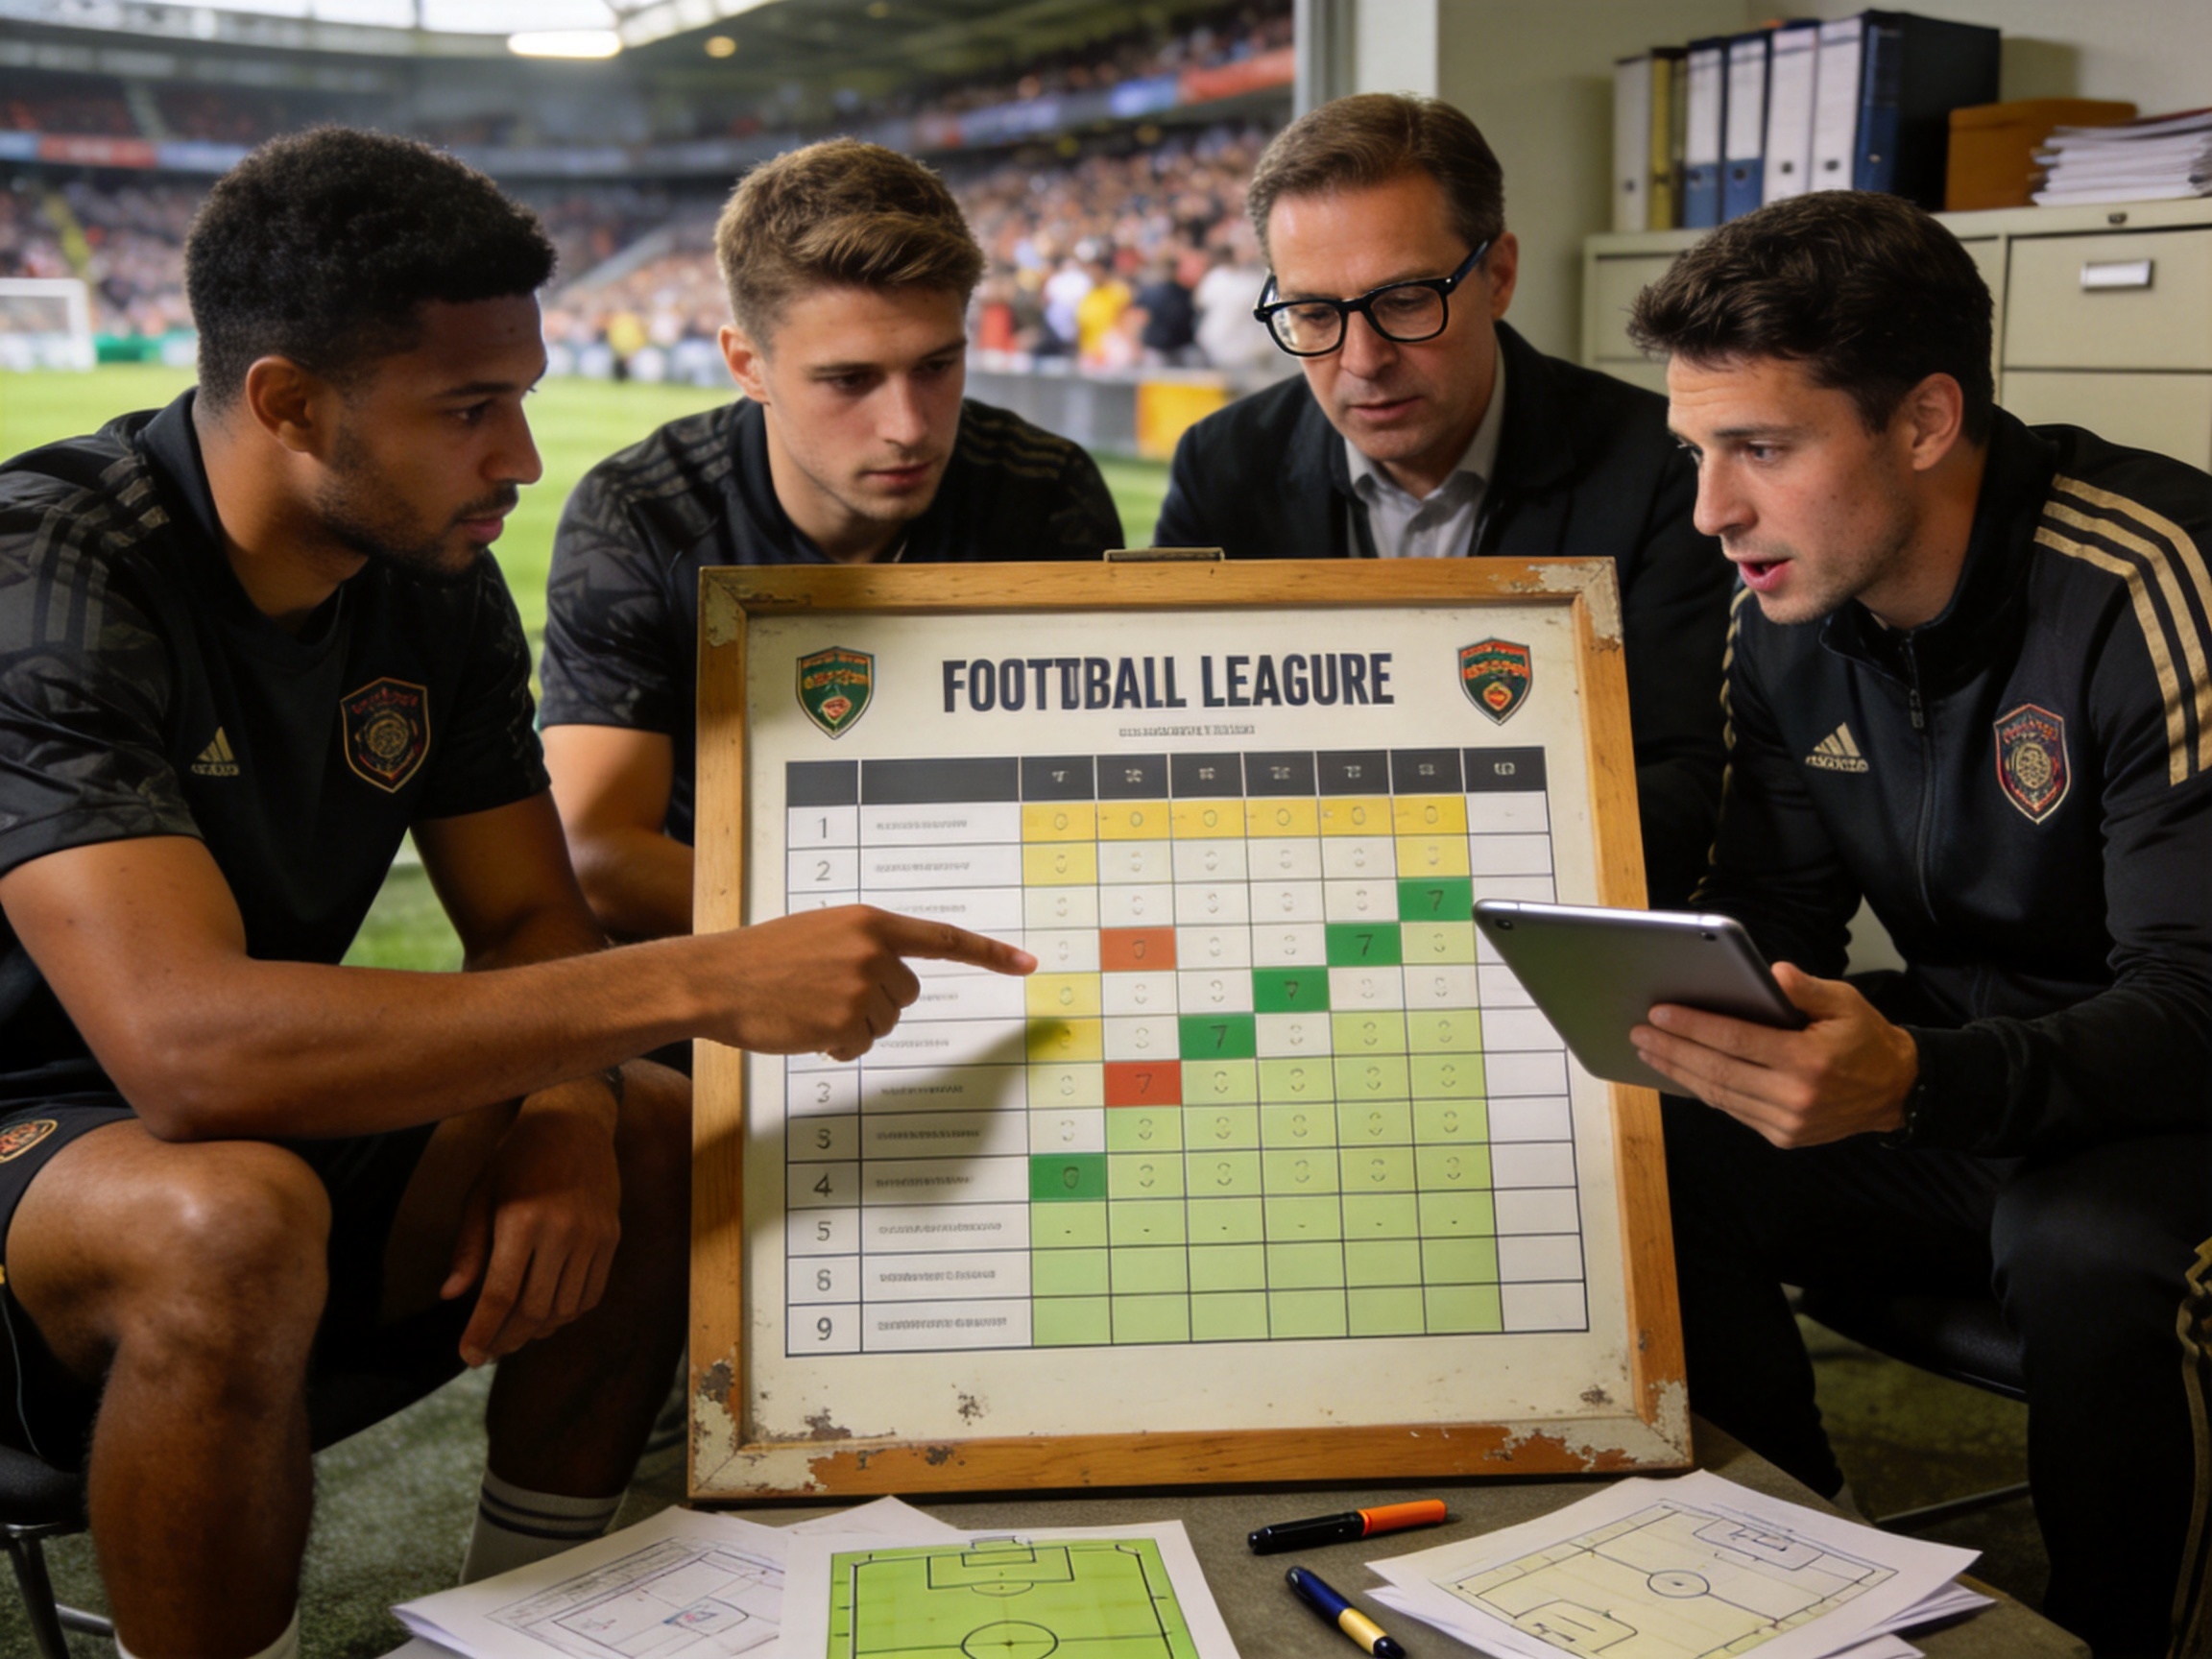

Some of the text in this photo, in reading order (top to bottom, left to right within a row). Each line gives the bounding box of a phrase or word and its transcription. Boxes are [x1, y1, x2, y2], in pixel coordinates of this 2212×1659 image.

[1200, 652, 1395, 708] LEAGURE
[817, 816, 828, 840] 1
[814, 860, 831, 882] 2
[1428, 889, 1444, 912] 7
[1355, 933, 1374, 957] 7
[1210, 1024, 1228, 1051] 7
[812, 1172, 833, 1198] 4
[816, 1220, 832, 1242] 5
[816, 1316, 833, 1341] 9
